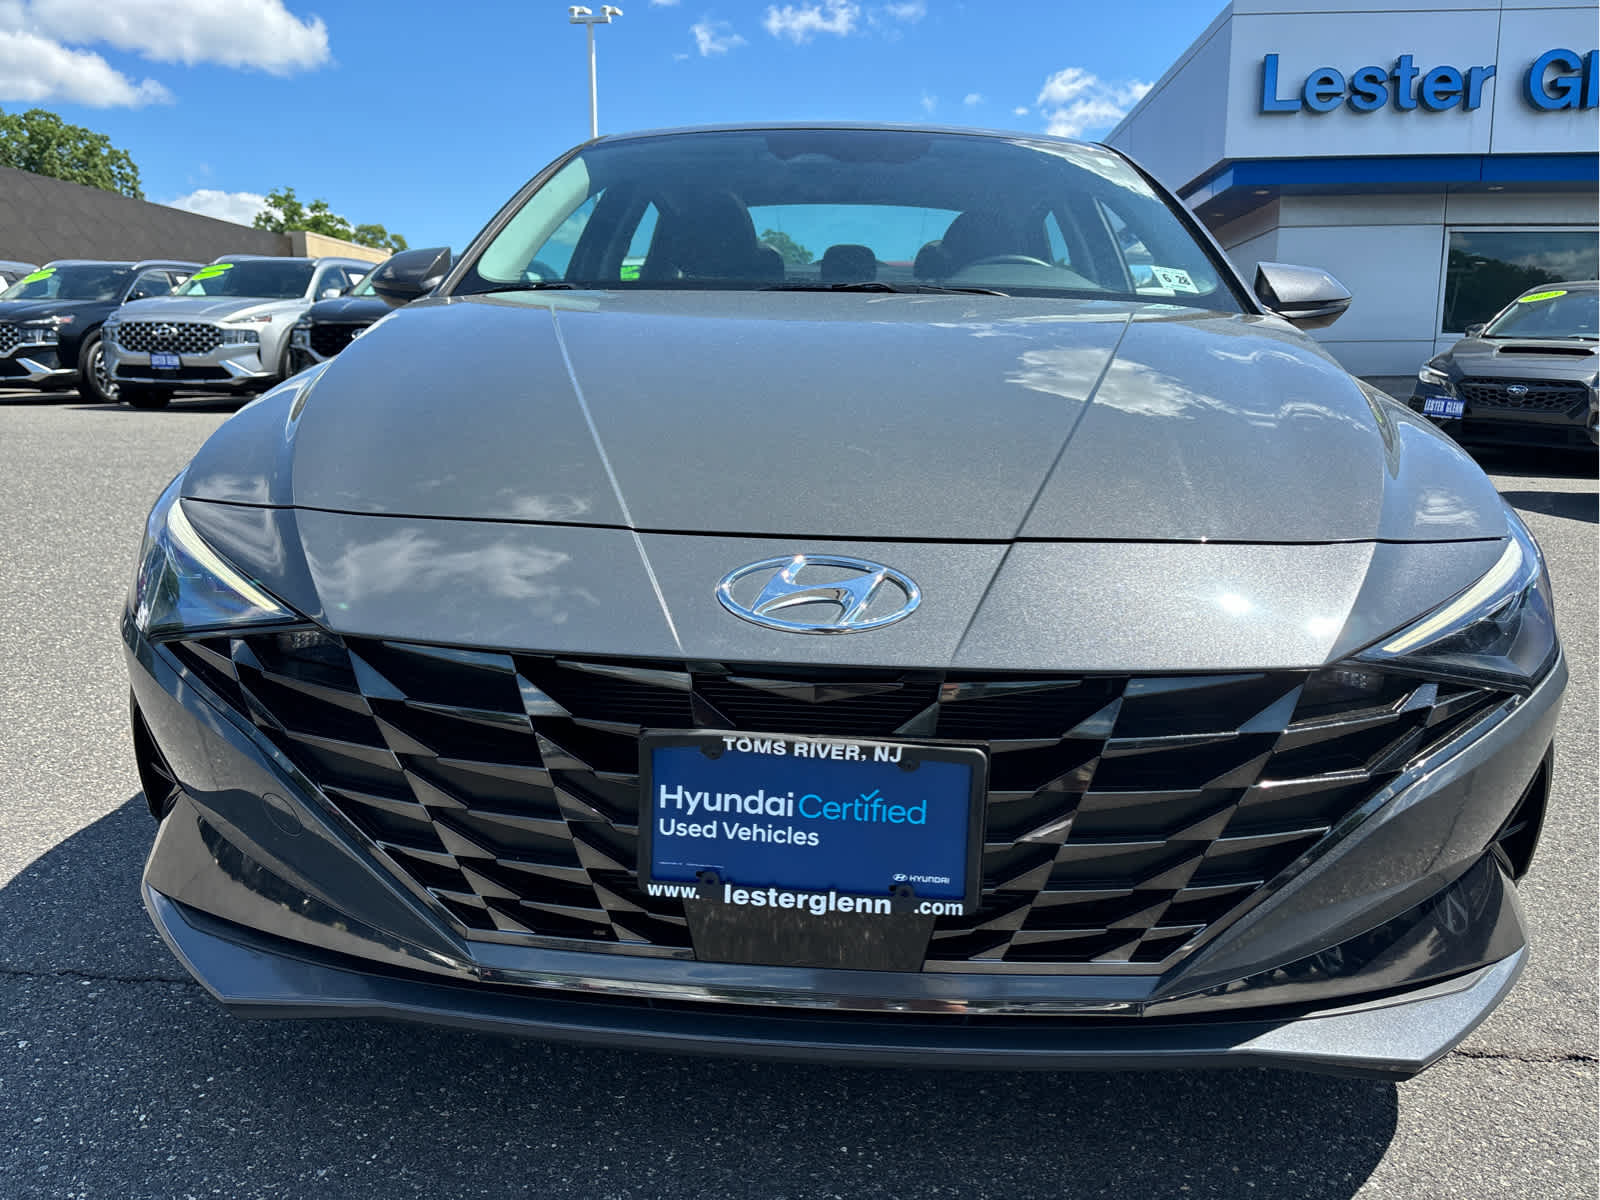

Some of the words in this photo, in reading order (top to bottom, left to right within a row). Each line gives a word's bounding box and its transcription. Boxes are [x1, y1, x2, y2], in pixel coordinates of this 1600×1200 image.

[1261, 53, 1497, 113] Lester
[722, 736, 786, 756] TOMS
[793, 742, 867, 763] RIVER,
[874, 746, 903, 763] NJ
[659, 784, 794, 817] Hyundai
[798, 789, 927, 825] Certified
[659, 818, 717, 840] Used
[722, 822, 820, 846] Vehicles
[908, 875, 951, 885] HYUNDAI
[647, 882, 700, 900] www.
[723, 883, 892, 916] lesterglenn
[913, 900, 964, 917] .com
